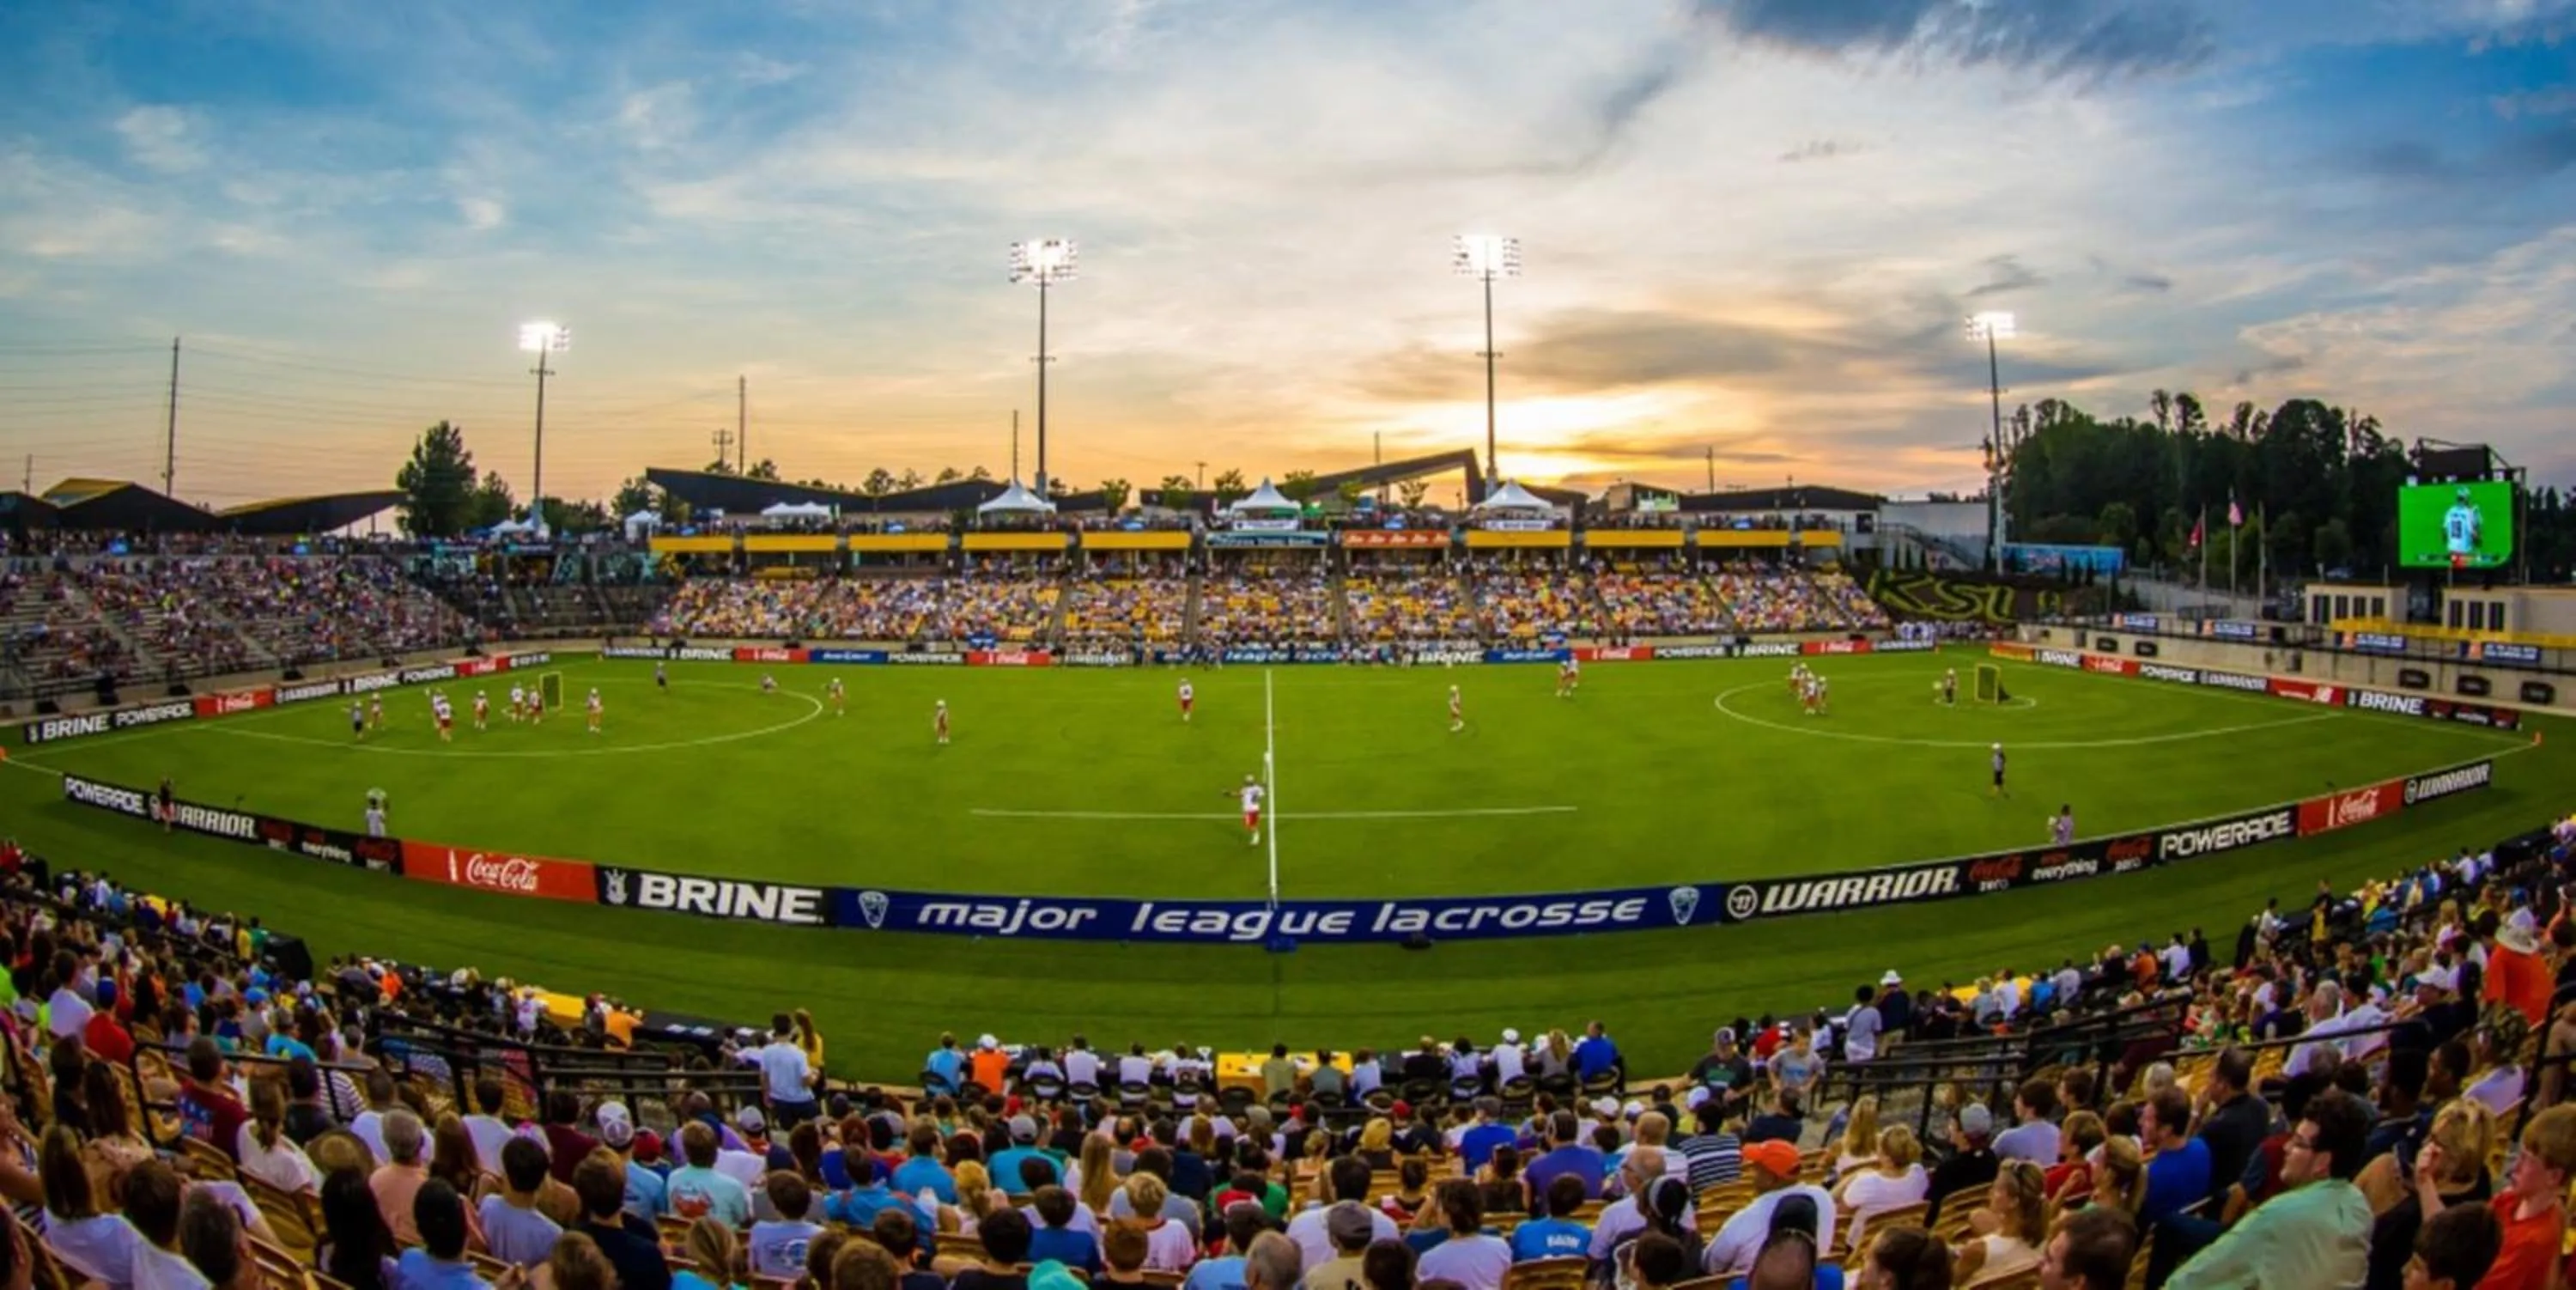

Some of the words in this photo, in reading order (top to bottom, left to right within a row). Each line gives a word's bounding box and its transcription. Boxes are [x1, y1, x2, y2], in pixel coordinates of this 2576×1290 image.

[2360, 691, 2424, 715] BRINE
[42, 713, 110, 741] BRINE
[64, 777, 146, 814] POWERADE
[2159, 810, 2293, 859] POWERADE
[2032, 858, 2099, 879] everything
[638, 873, 824, 924] BRINE
[1761, 867, 1960, 913] WARRIOR
[917, 899, 1098, 934] major
[1131, 903, 1355, 940] league
[1371, 898, 1647, 933] lacrosse
